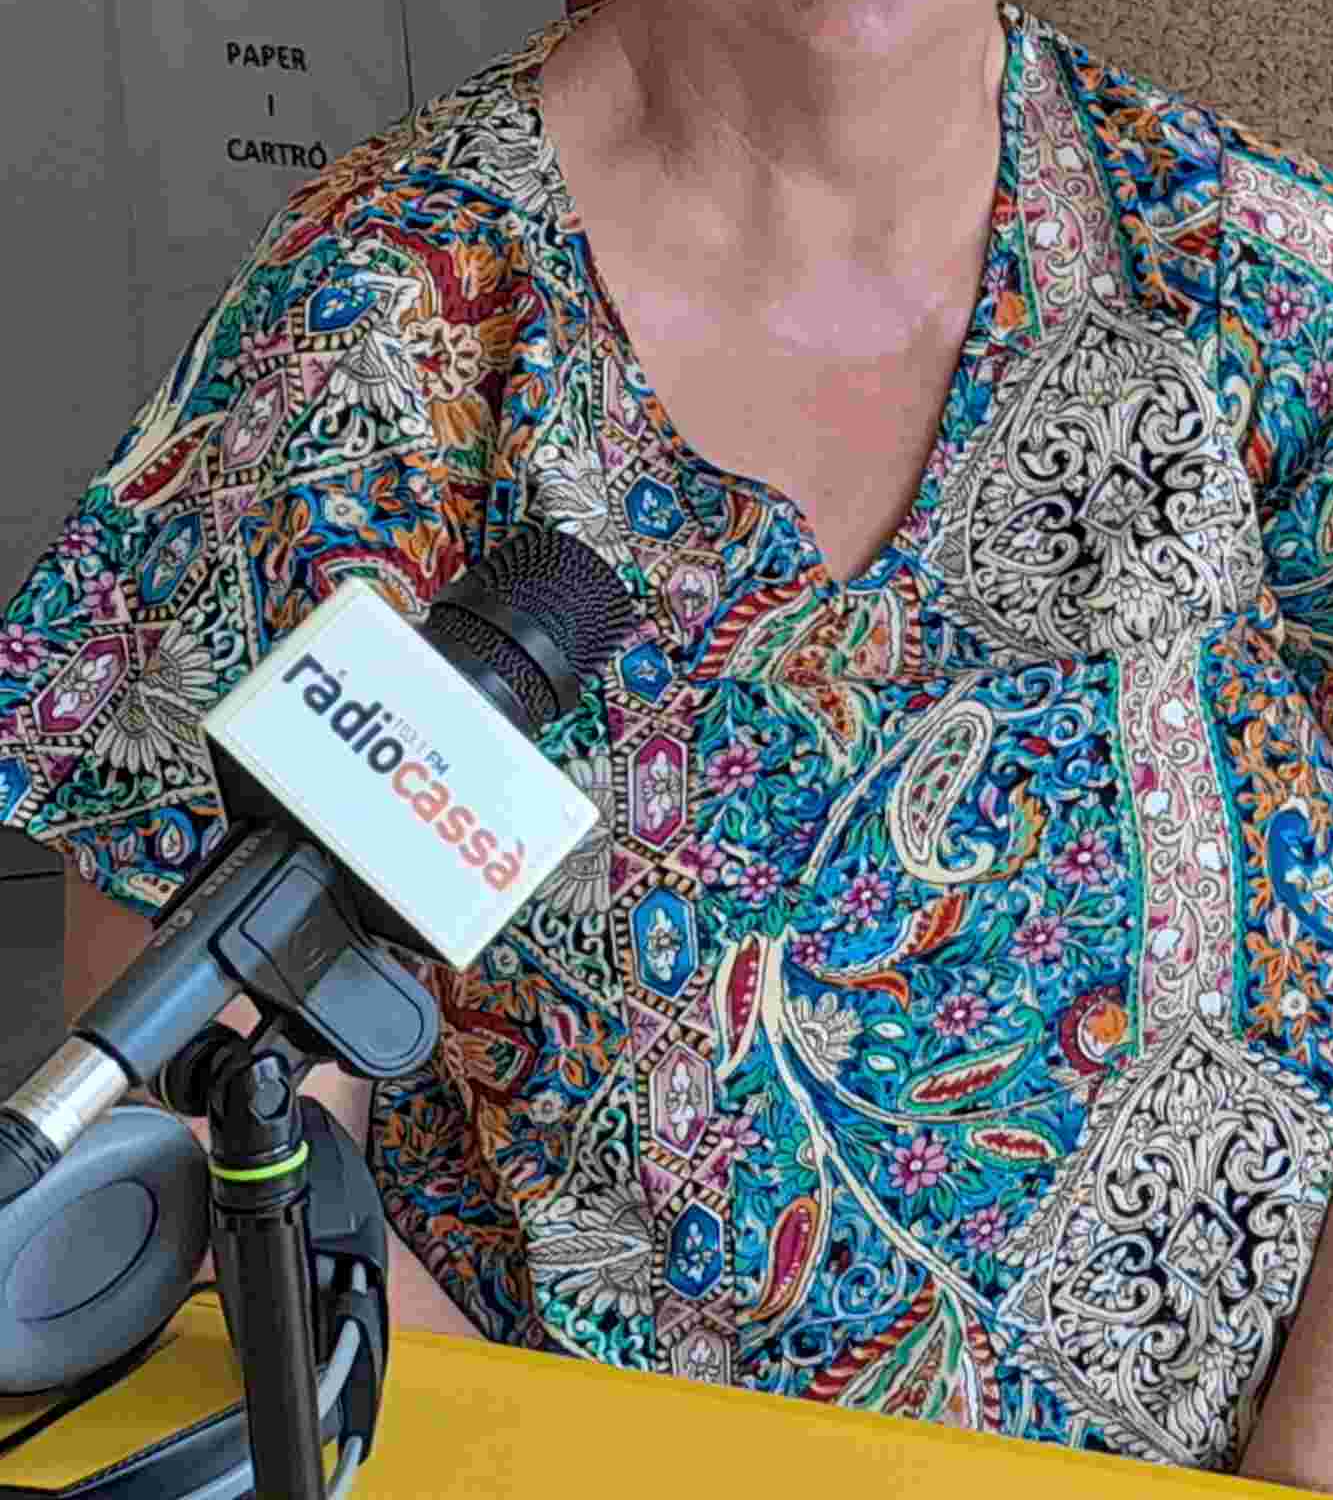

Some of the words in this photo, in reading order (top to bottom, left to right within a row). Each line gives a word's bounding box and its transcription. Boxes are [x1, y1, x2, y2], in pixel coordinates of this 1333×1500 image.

[226, 41, 308, 72] PAPER
[267, 92, 275, 117] I
[226, 138, 327, 170] CARTRÓ
